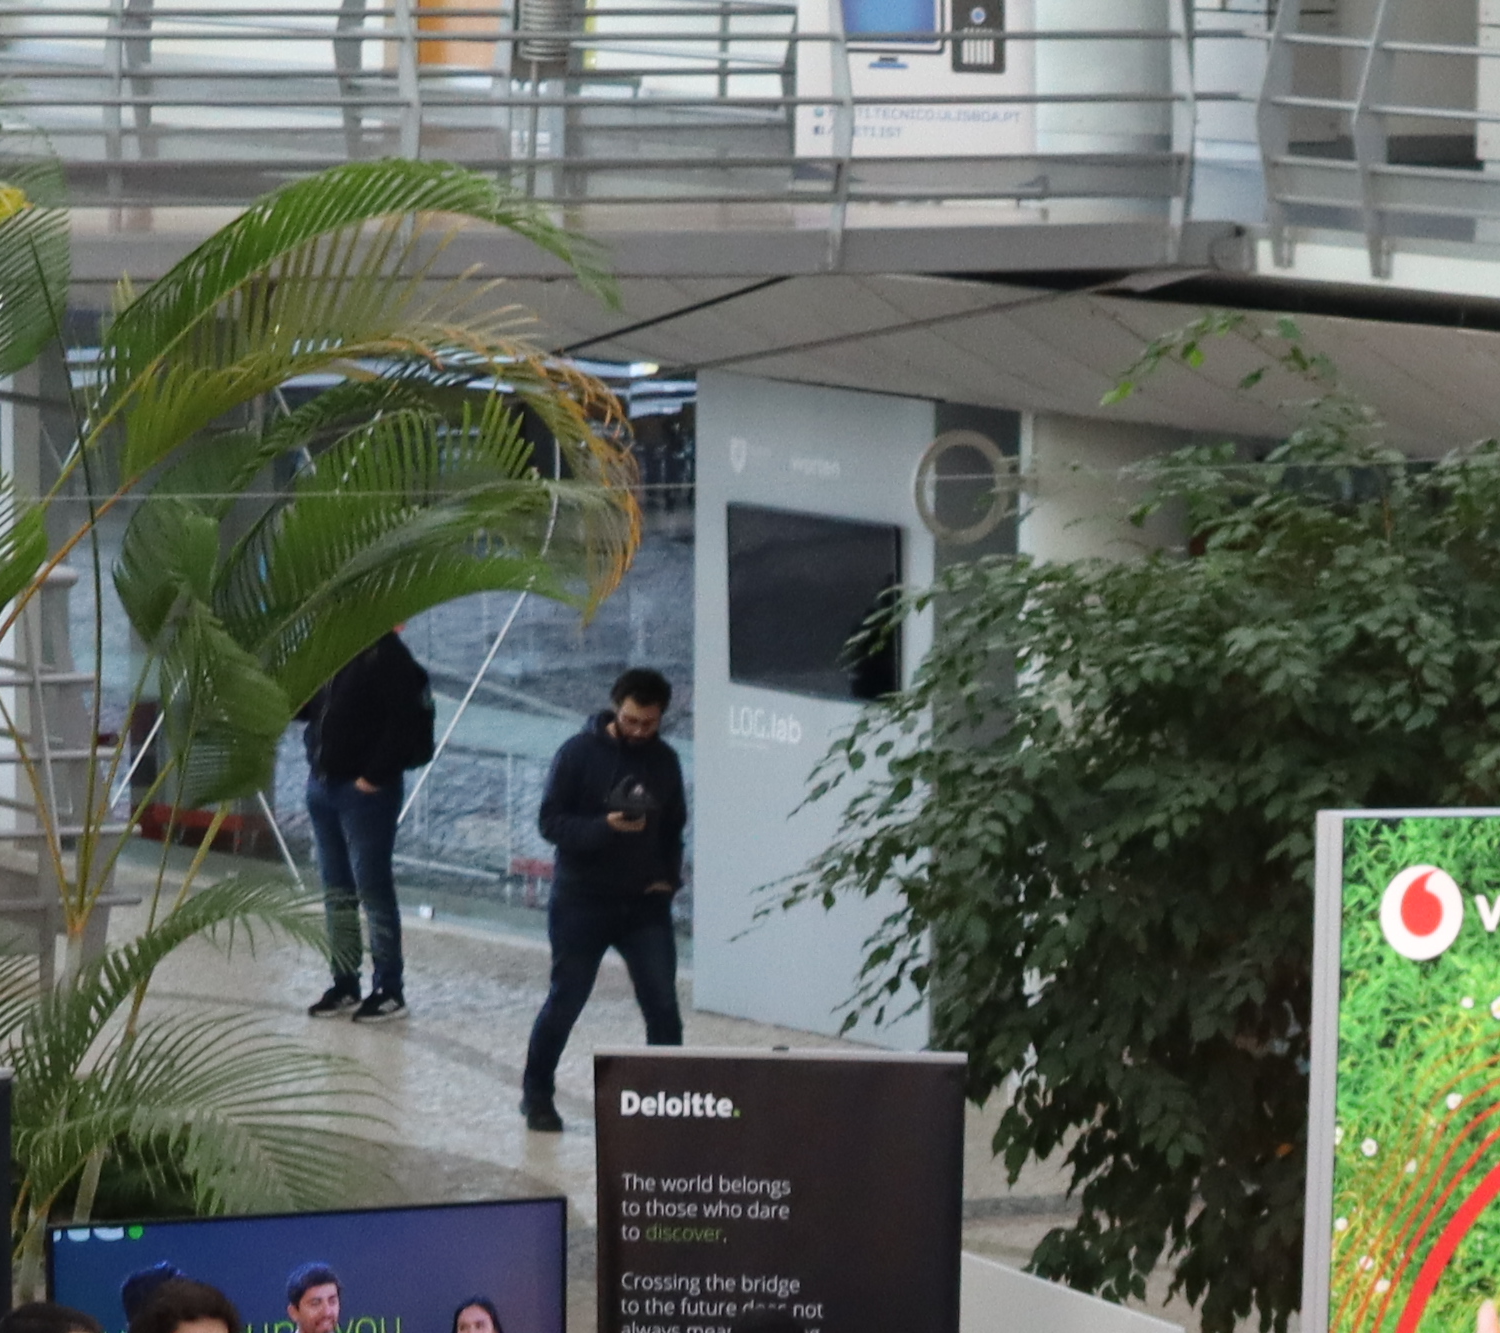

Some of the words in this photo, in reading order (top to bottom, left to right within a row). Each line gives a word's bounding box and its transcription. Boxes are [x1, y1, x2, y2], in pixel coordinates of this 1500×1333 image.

[620, 1090, 741, 1118] Deloitte.
[622, 1172, 656, 1192] The
[661, 1174, 713, 1194] world
[719, 1176, 792, 1199] belongs
[621, 1201, 640, 1217] to
[646, 1198, 698, 1218] those
[703, 1200, 742, 1219] who
[747, 1201, 790, 1220] dare
[621, 1225, 640, 1242] to
[621, 1272, 701, 1296] Crossing
[705, 1274, 736, 1292] the
[741, 1275, 801, 1298] bridge
[621, 1299, 640, 1316] to
[645, 1297, 676, 1316] the
[680, 1297, 738, 1318] future
[793, 1303, 823, 1319] not
